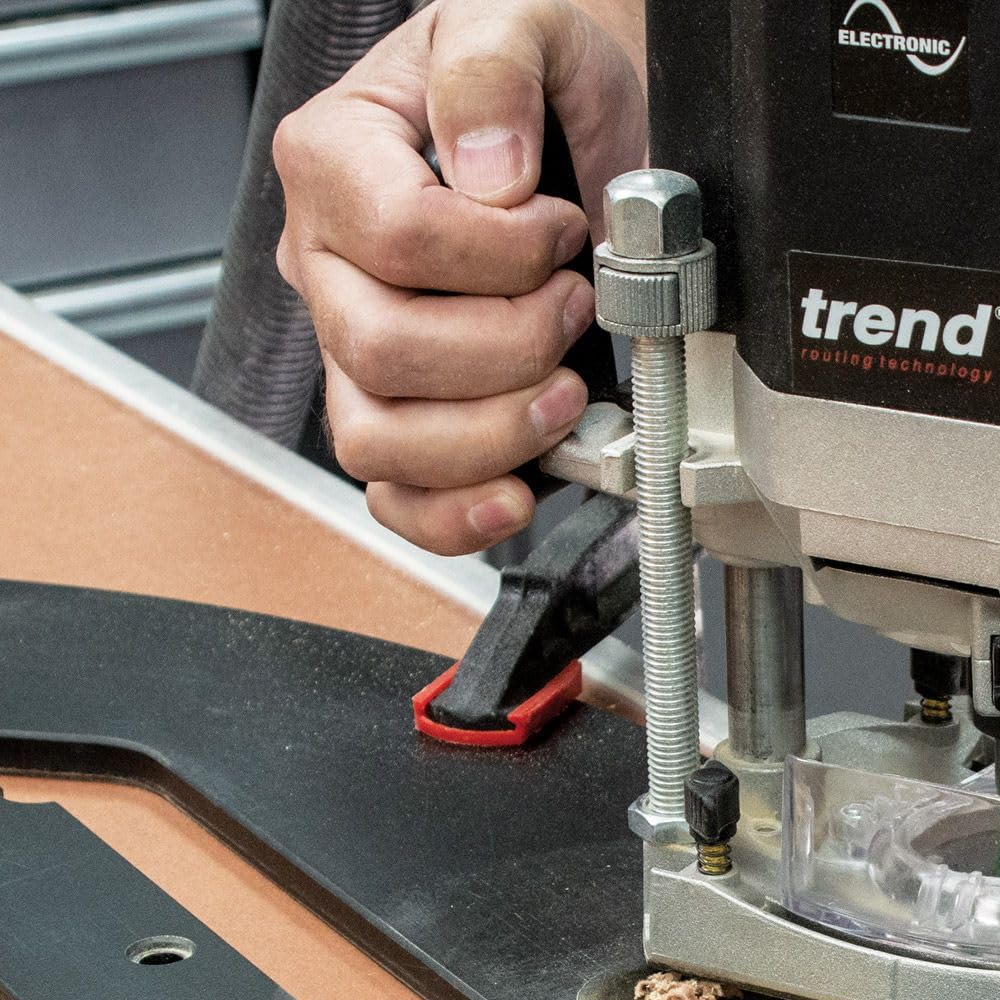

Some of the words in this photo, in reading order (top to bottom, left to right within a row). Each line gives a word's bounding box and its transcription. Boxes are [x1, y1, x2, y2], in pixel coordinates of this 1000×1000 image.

[838, 28, 951, 56] ELECTRONIC
[801, 348, 874, 370] routing
[879, 354, 993, 384] technology
